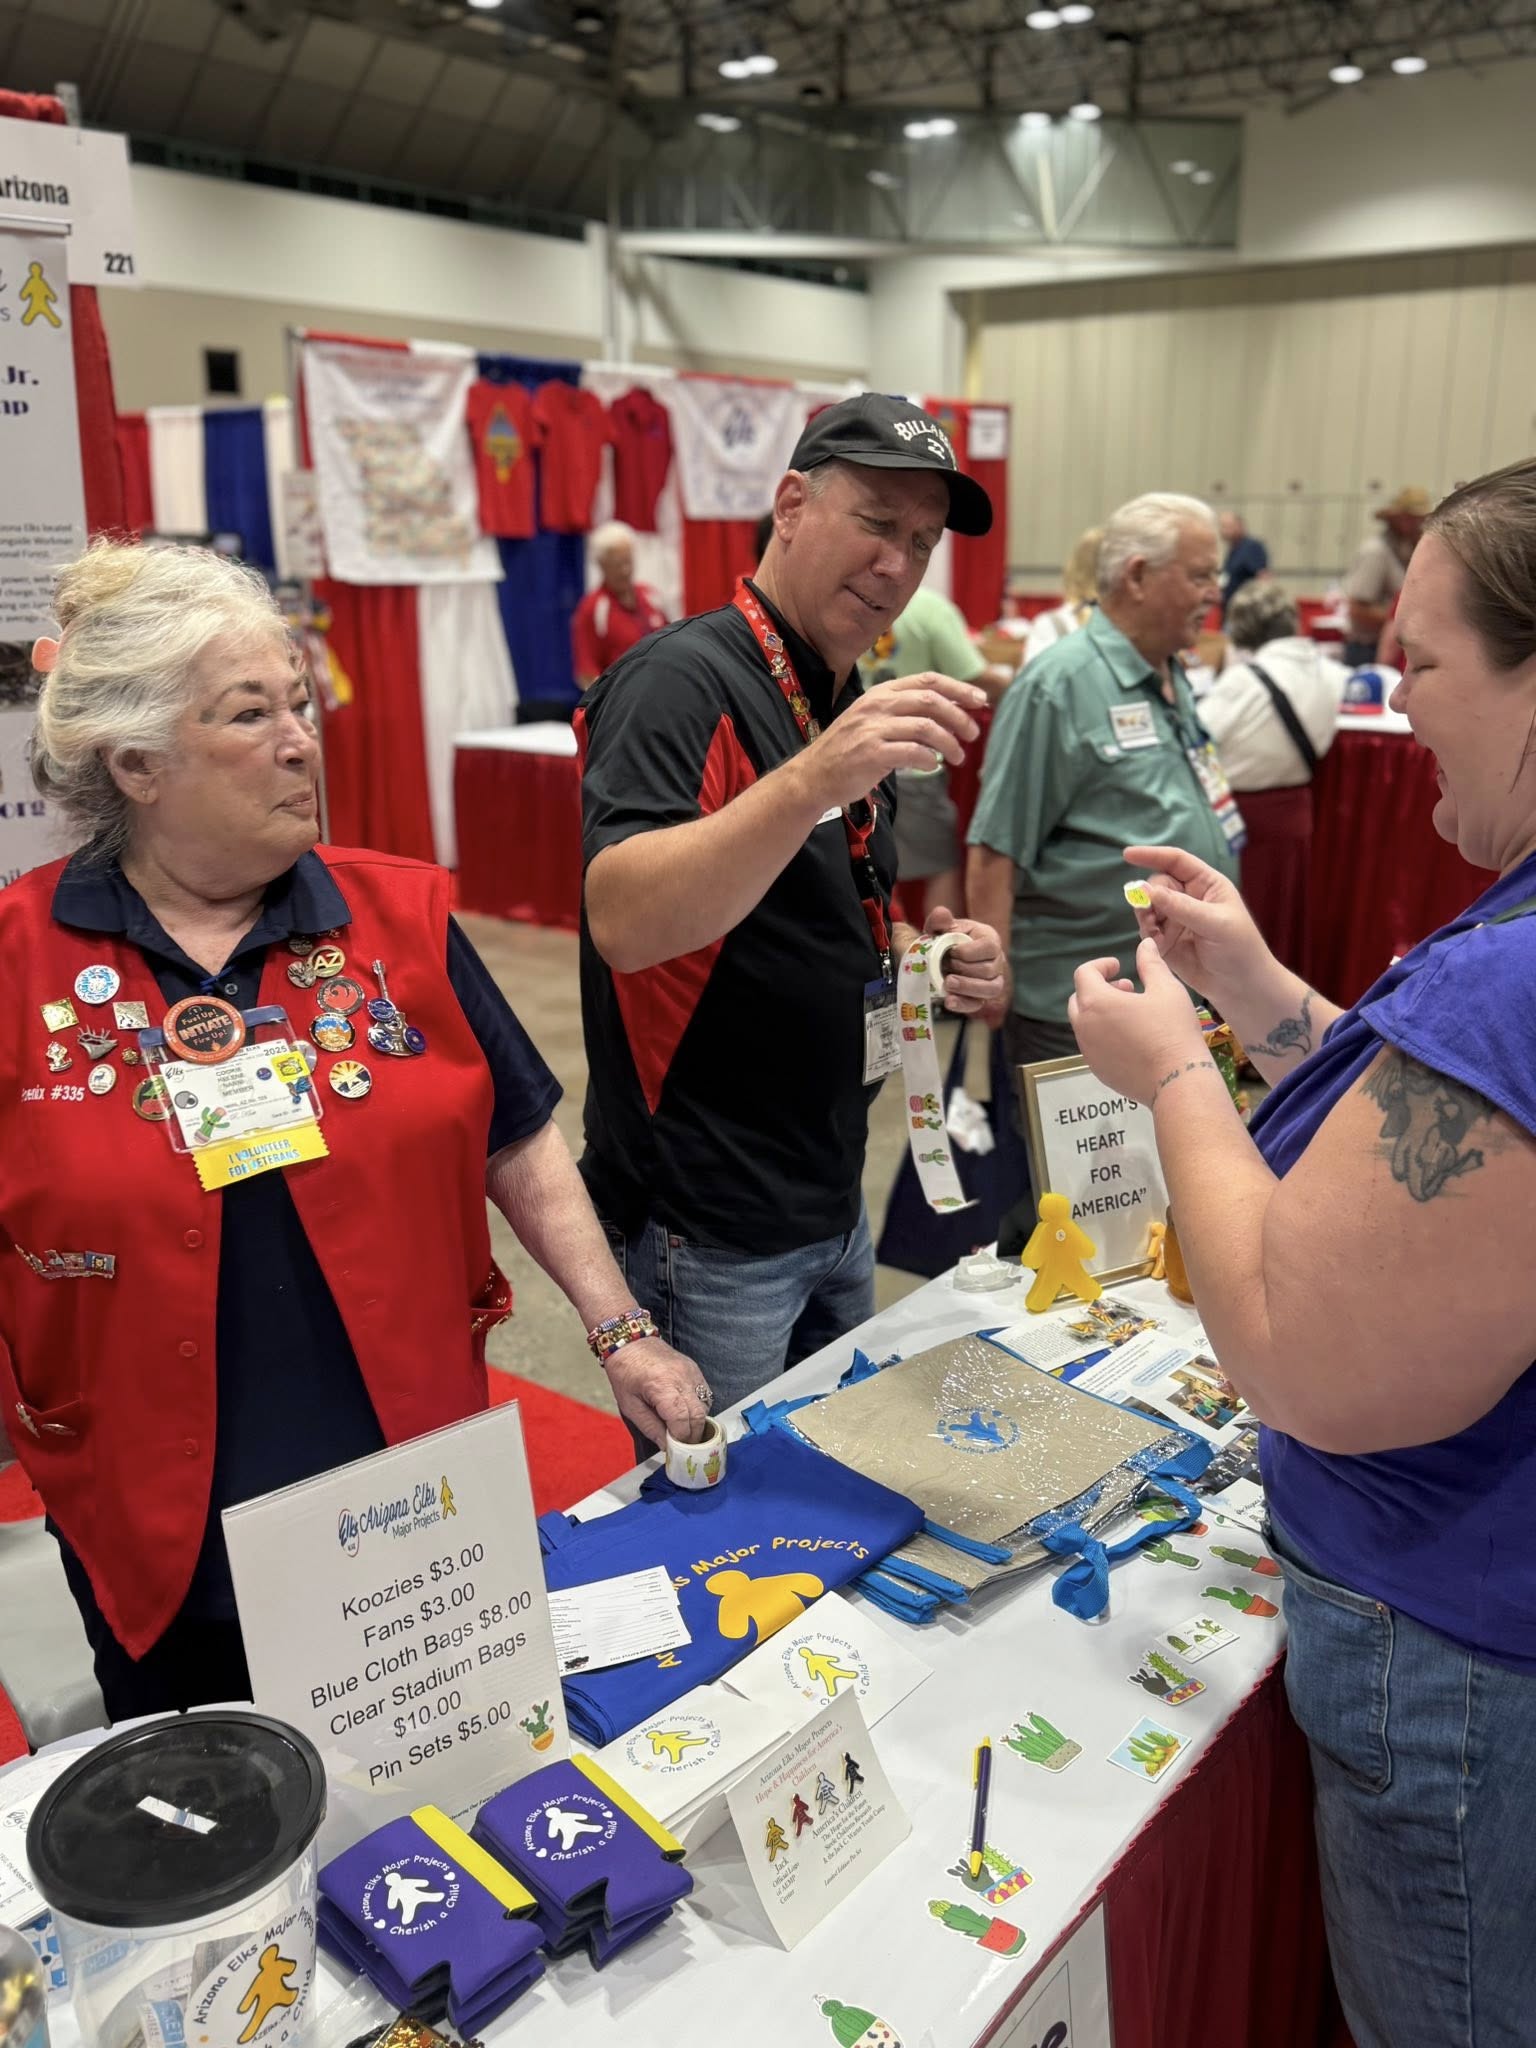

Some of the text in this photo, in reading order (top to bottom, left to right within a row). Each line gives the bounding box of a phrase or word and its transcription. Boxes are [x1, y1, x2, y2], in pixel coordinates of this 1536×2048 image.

[0, 174, 69, 206] rizona
[104, 252, 135, 275] 221
[313, 951, 342, 972] AZ
[263, 1046, 288, 1057] 2025
[51, 1084, 85, 1102] #335
[235, 1139, 292, 1162] VOLUNTEER
[250, 1149, 300, 1171] VETERANS
[1076, 1130, 1126, 1154] HEART
[1090, 1164, 1122, 1184] FOR
[360, 1482, 437, 1534] Arizona Elks
[392, 1510, 441, 1539] Major Projects
[691, 1536, 869, 1575] Major Projects
[342, 1543, 484, 1621] Koozies $3.00
[363, 1582, 475, 1648] Fans $3.00
[310, 1676, 359, 1709] Blue
[365, 1646, 418, 1682] Cloth
[424, 1622, 474, 1656] Bags
[479, 1591, 532, 1630] $8.00
[782, 1632, 852, 1689] Arizona Elks Major Projects
[330, 1632, 527, 1736] Clear Stadium Bags
[858, 1664, 870, 1687] Child
[393, 1690, 462, 1739] $10.00
[369, 1700, 511, 1787] Pin Sets $5.00
[660, 1756, 706, 1773] Cherish
[760, 1720, 834, 1786] Arizona Elks Major Projects
[524, 1793, 608, 1851] Arizona Elks Major Projects
[812, 1790, 863, 1839] America's Children
[550, 1845, 597, 1861] Cherish
[604, 1820, 617, 1839] Child
[361, 1855, 451, 1921] Arizona Elks Major Projects
[774, 1856, 789, 1875] Jack
[389, 1883, 460, 1936] Cherish a Child
[193, 1975, 229, 2024] Arizona
[227, 1944, 259, 1972] Elks
[263, 1914, 297, 1944] Major
[280, 1969, 312, 2042] a Child
